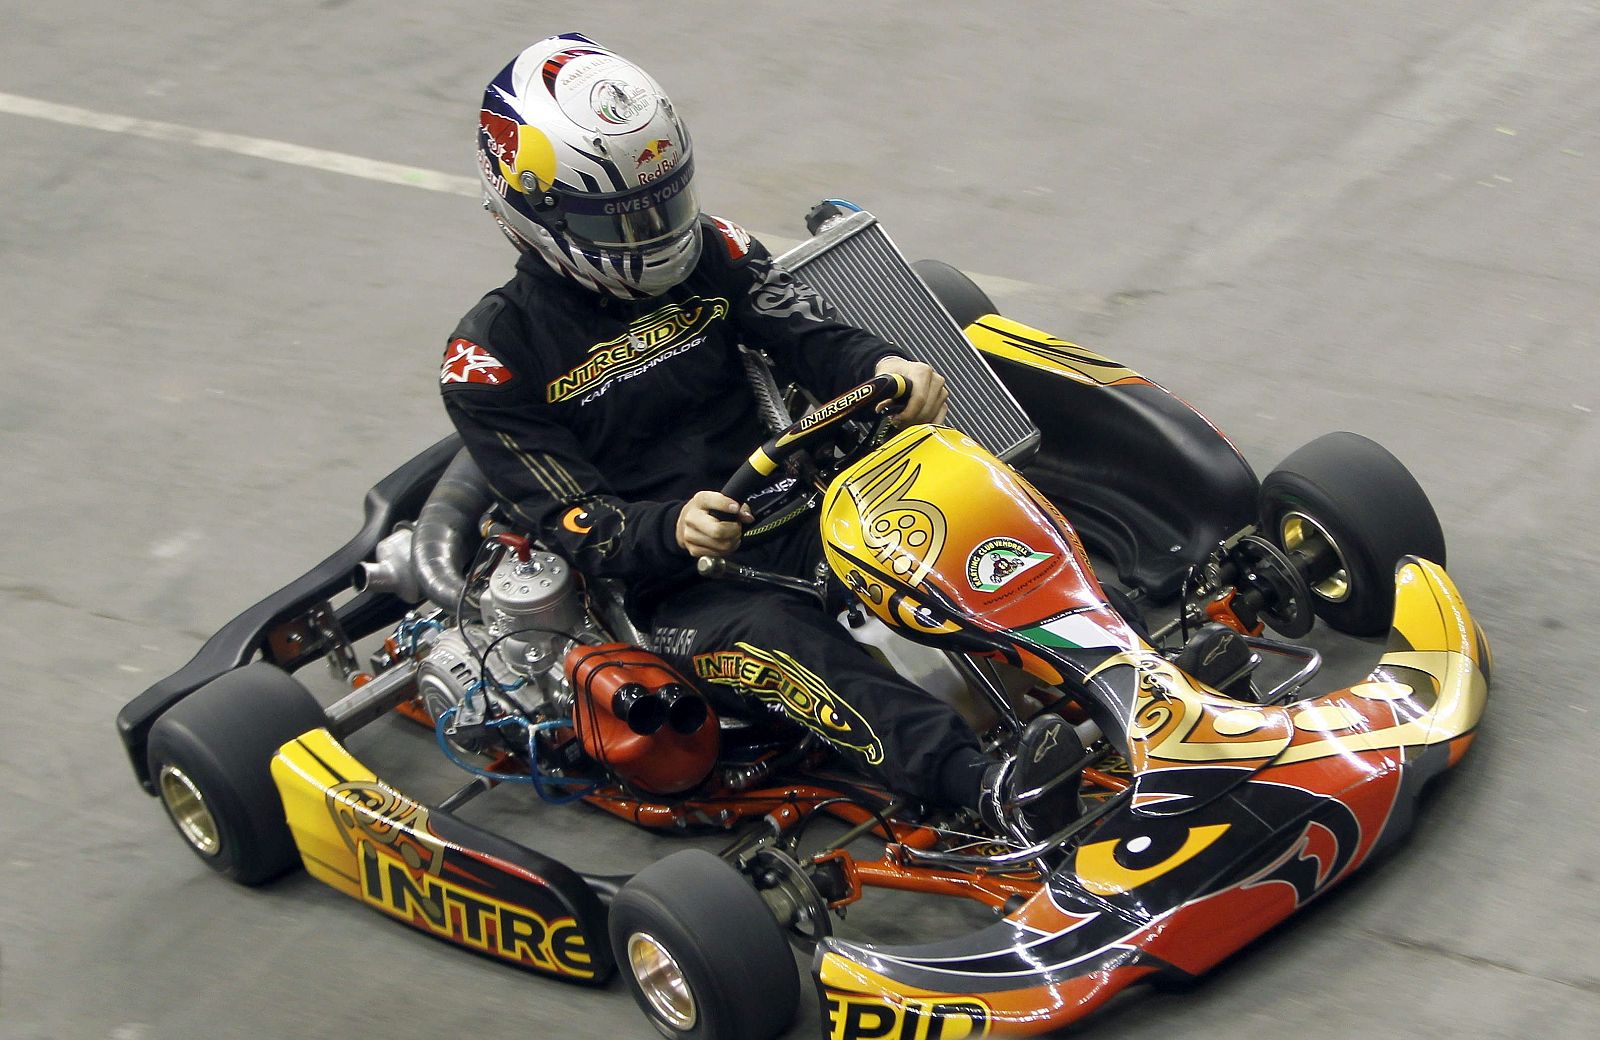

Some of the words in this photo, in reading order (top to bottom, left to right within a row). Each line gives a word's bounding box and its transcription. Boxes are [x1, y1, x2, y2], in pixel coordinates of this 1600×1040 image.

[637, 164, 662, 187] Red
[661, 150, 679, 172] Bull
[604, 196, 650, 215] GIVES
[653, 183, 679, 203] YOU
[616, 335, 708, 382] TECHNOLOGY
[801, 384, 874, 430] INTREPID
[970, 555, 982, 587] KARTING
[979, 541, 995, 556] CLUB
[1040, 610, 1072, 625] ITALIAN
[357, 841, 595, 978] INTRE
